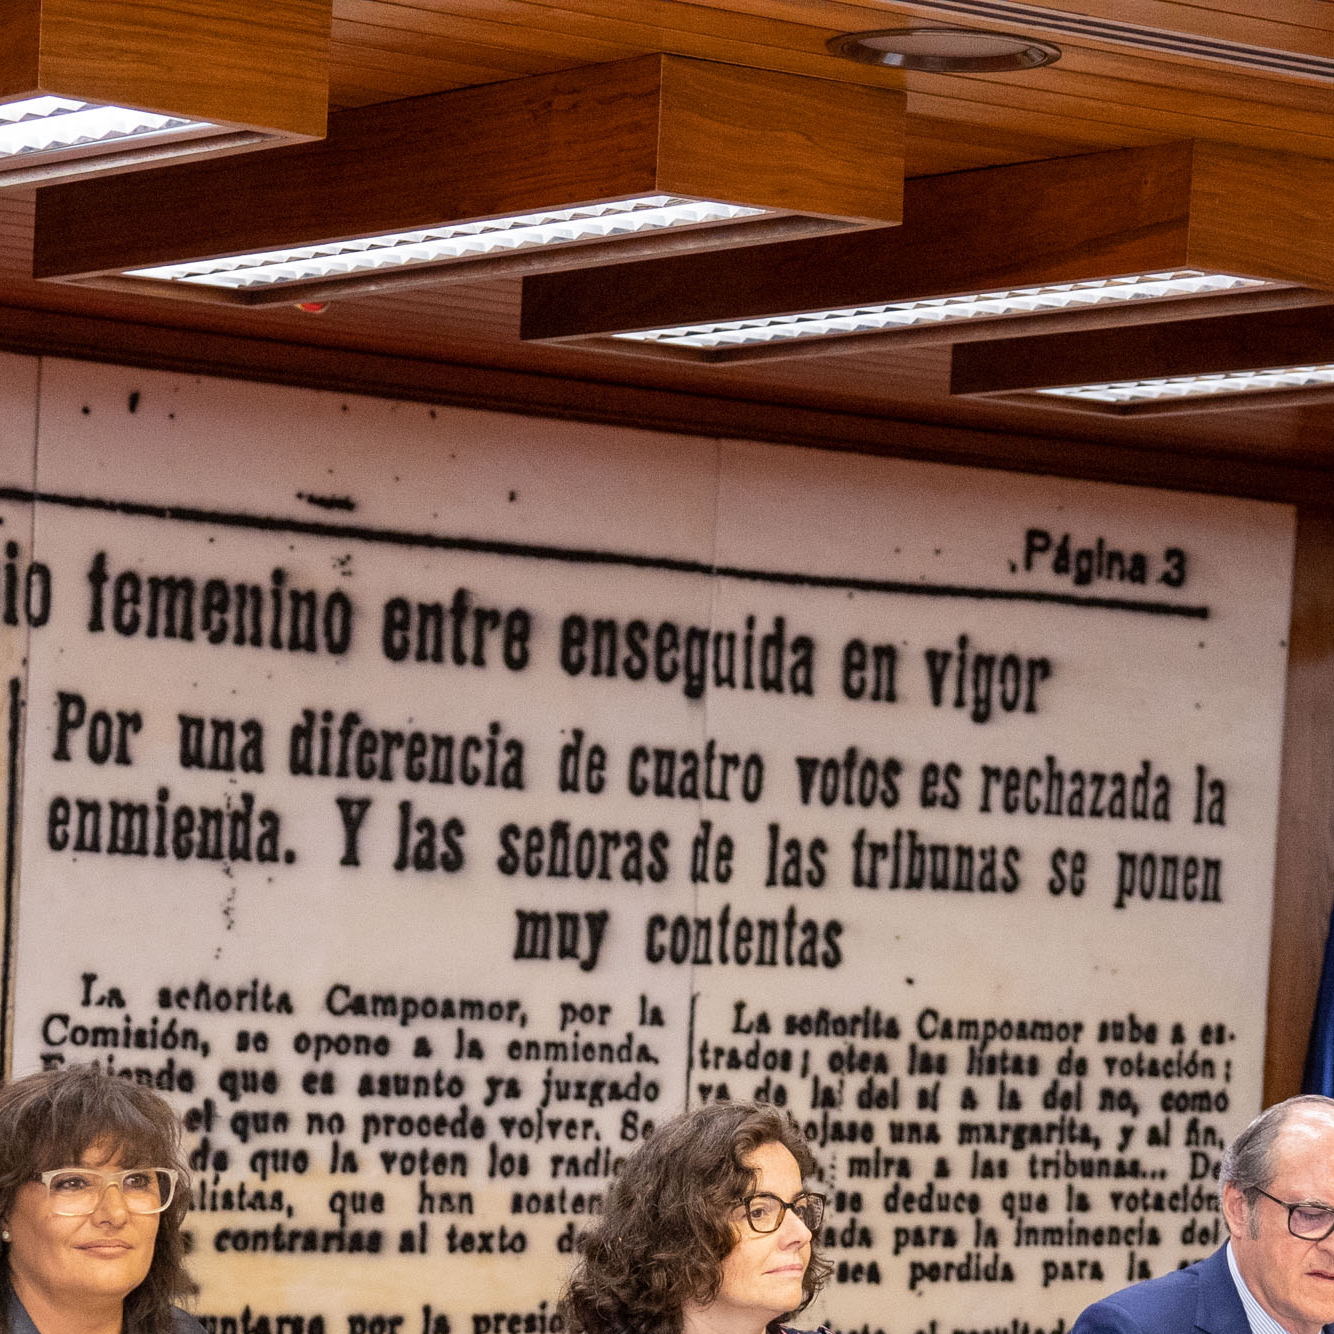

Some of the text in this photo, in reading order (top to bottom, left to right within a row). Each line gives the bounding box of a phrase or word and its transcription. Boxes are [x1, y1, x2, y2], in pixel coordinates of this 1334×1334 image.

[1023, 528, 1148, 588] Página
[87, 550, 355, 657] femenino
[382, 585, 532, 671] entre
[560, 610, 815, 700] enseguida
[842, 636, 899, 703] en
[924, 635, 1053, 723] vigor
[53, 690, 1227, 826] Por una diferencia de cuatro votos es rechazada la
[46, 784, 1224, 909] enmienda. Y las señoras de las tribunas se ponen
[514, 904, 845, 971] muy contentas
[81, 972, 665, 1031] La señorita Campoamor, por la
[41, 1013, 211, 1058] Comisión,
[236, 1029, 269, 1053] se
[293, 1031, 392, 1062] opone
[413, 1035, 433, 1058] a
[455, 1027, 485, 1060] la
[732, 1000, 772, 1035] La
[784, 1005, 901, 1040] señorita
[917, 1007, 1085, 1052] Campoamor
[1097, 1011, 1158, 1046] sube
[1171, 1022, 1186, 1046] a
[907, 1042, 948, 1076] las
[967, 1044, 1040, 1077] listas
[1057, 1046, 1089, 1077] de
[219, 1067, 660, 1108] que es asunto ya juzgado
[184, 1098, 213, 1133] el
[230, 1110, 291, 1143] que
[306, 1111, 345, 1138] no
[361, 1104, 487, 1144] procede
[888, 1121, 941, 1145] una
[958, 1115, 1101, 1151] margarita,
[1117, 1124, 1135, 1152] y
[1146, 1116, 1171, 1147] al
[847, 1147, 1167, 1180] mira a las tribunas...
[883, 1181, 981, 1214] deduce
[1001, 1191, 1049, 1220] que
[1065, 1183, 1091, 1212] la
[213, 1221, 528, 1255] contrarias al texto
[893, 1215, 1221, 1256] para la inminencia del
